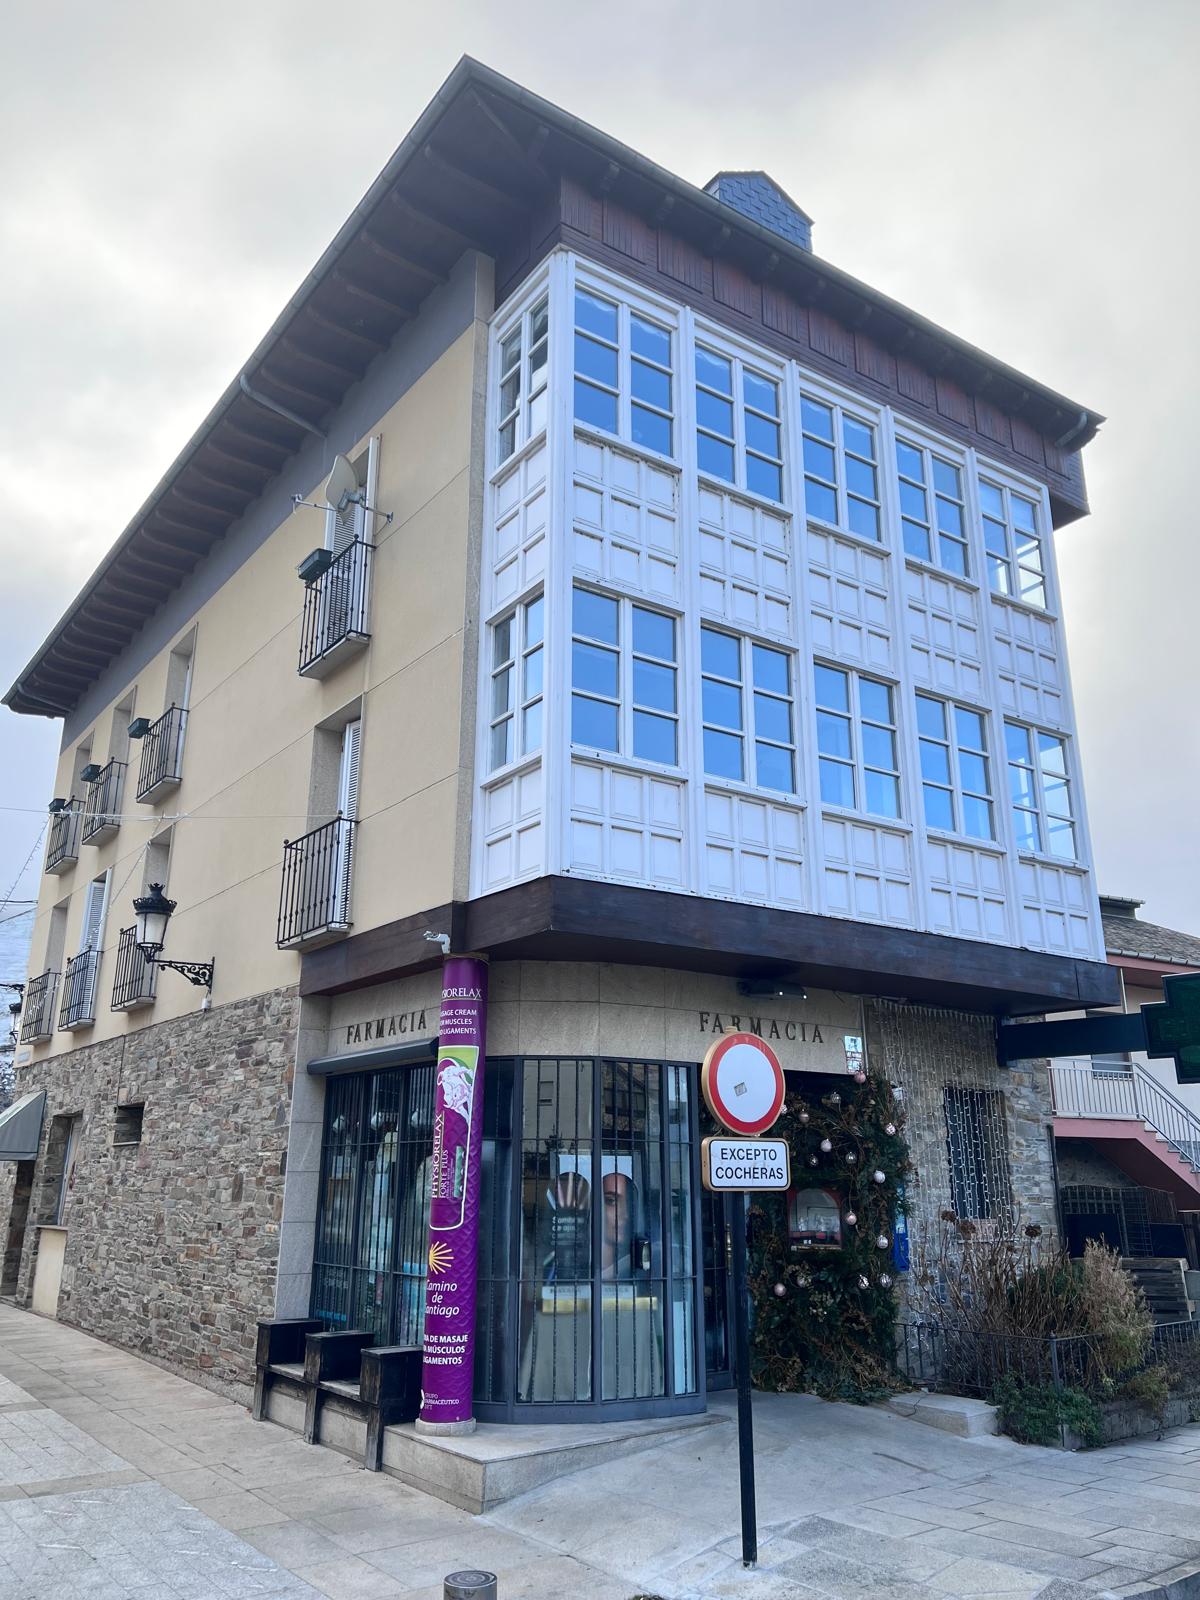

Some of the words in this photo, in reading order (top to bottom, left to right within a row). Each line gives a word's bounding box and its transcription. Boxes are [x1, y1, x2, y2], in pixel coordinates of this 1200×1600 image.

[454, 1008, 477, 1016] CREAM
[346, 1009, 427, 1044] FARMACIA
[445, 1018, 473, 1026] MUSCLES
[699, 1011, 824, 1043] FARMACIA
[431, 1114, 444, 1198] PHYSIORELAX
[441, 1149, 449, 1169] PLUS
[720, 1147, 777, 1161] EXCEPTO
[715, 1166, 784, 1180] COCHERAS
[439, 1171, 447, 1198] FORTE
[431, 1291, 443, 1303] de
[429, 1335, 438, 1343] DE
[439, 1334, 469, 1343] MASAJE
